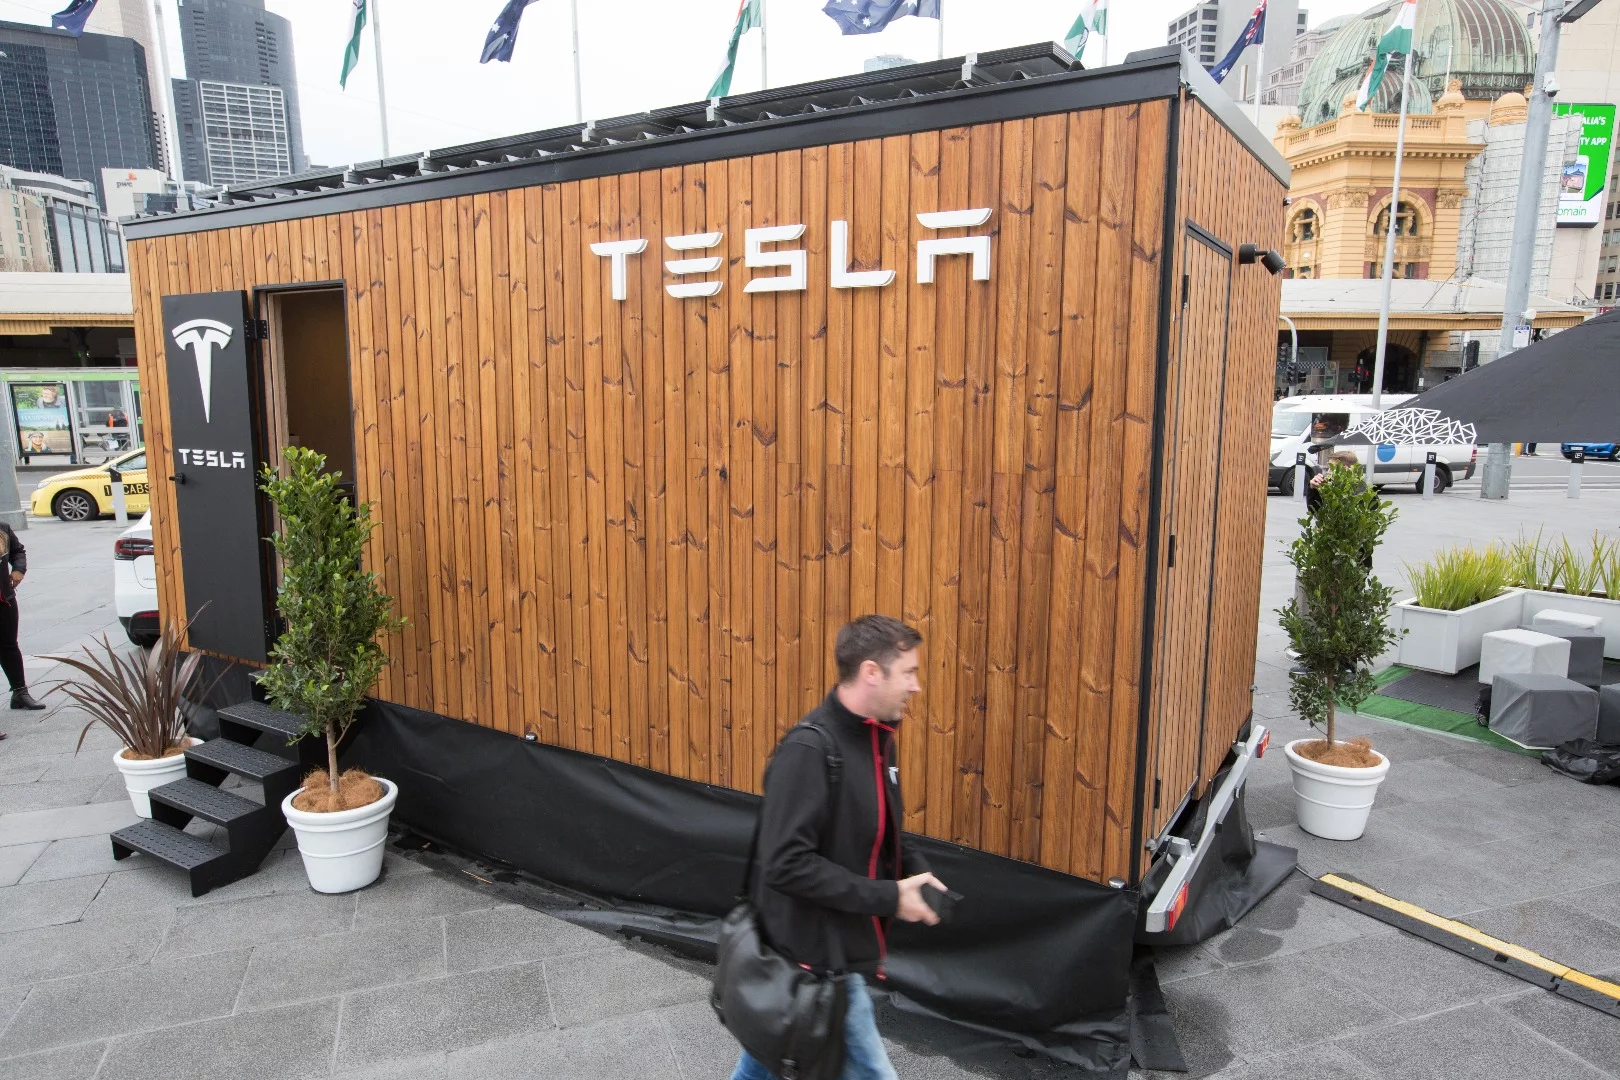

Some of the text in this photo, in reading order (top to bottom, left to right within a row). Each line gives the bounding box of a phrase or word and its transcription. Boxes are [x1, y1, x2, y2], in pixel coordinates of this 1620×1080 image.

[1582, 116, 1606, 125] ALIA'S
[1590, 138, 1607, 146] APP
[116, 181, 133, 189] pwc
[1557, 206, 1587, 216] omain
[589, 207, 993, 301] TESLA
[178, 448, 246, 469] TESLA
[104, 484, 149, 496] 1CABS
